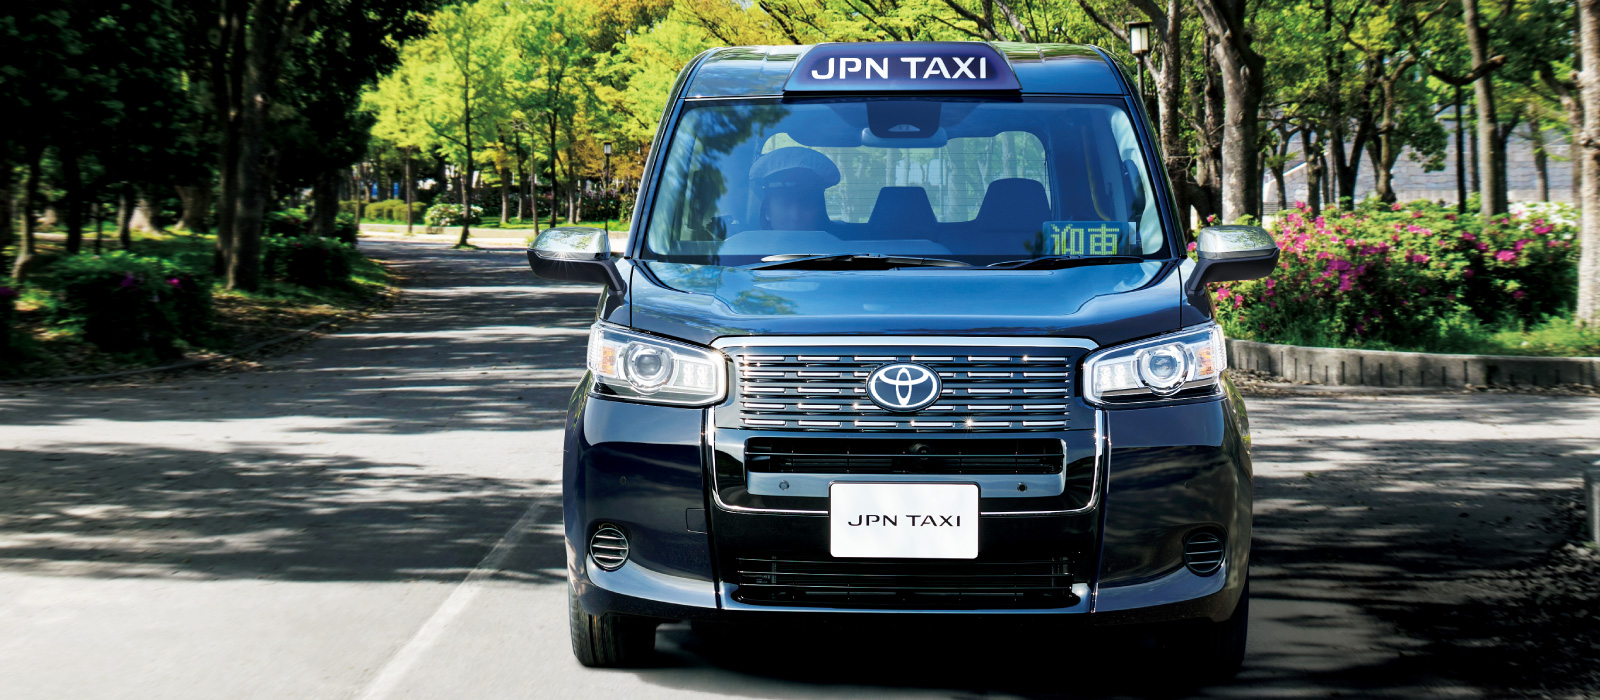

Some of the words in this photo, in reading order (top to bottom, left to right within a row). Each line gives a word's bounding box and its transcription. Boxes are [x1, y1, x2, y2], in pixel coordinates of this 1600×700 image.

[811, 57, 889, 79] JPN
[900, 57, 987, 79] TAXI
[847, 514, 898, 527] JPN
[905, 514, 960, 527] TAXI
